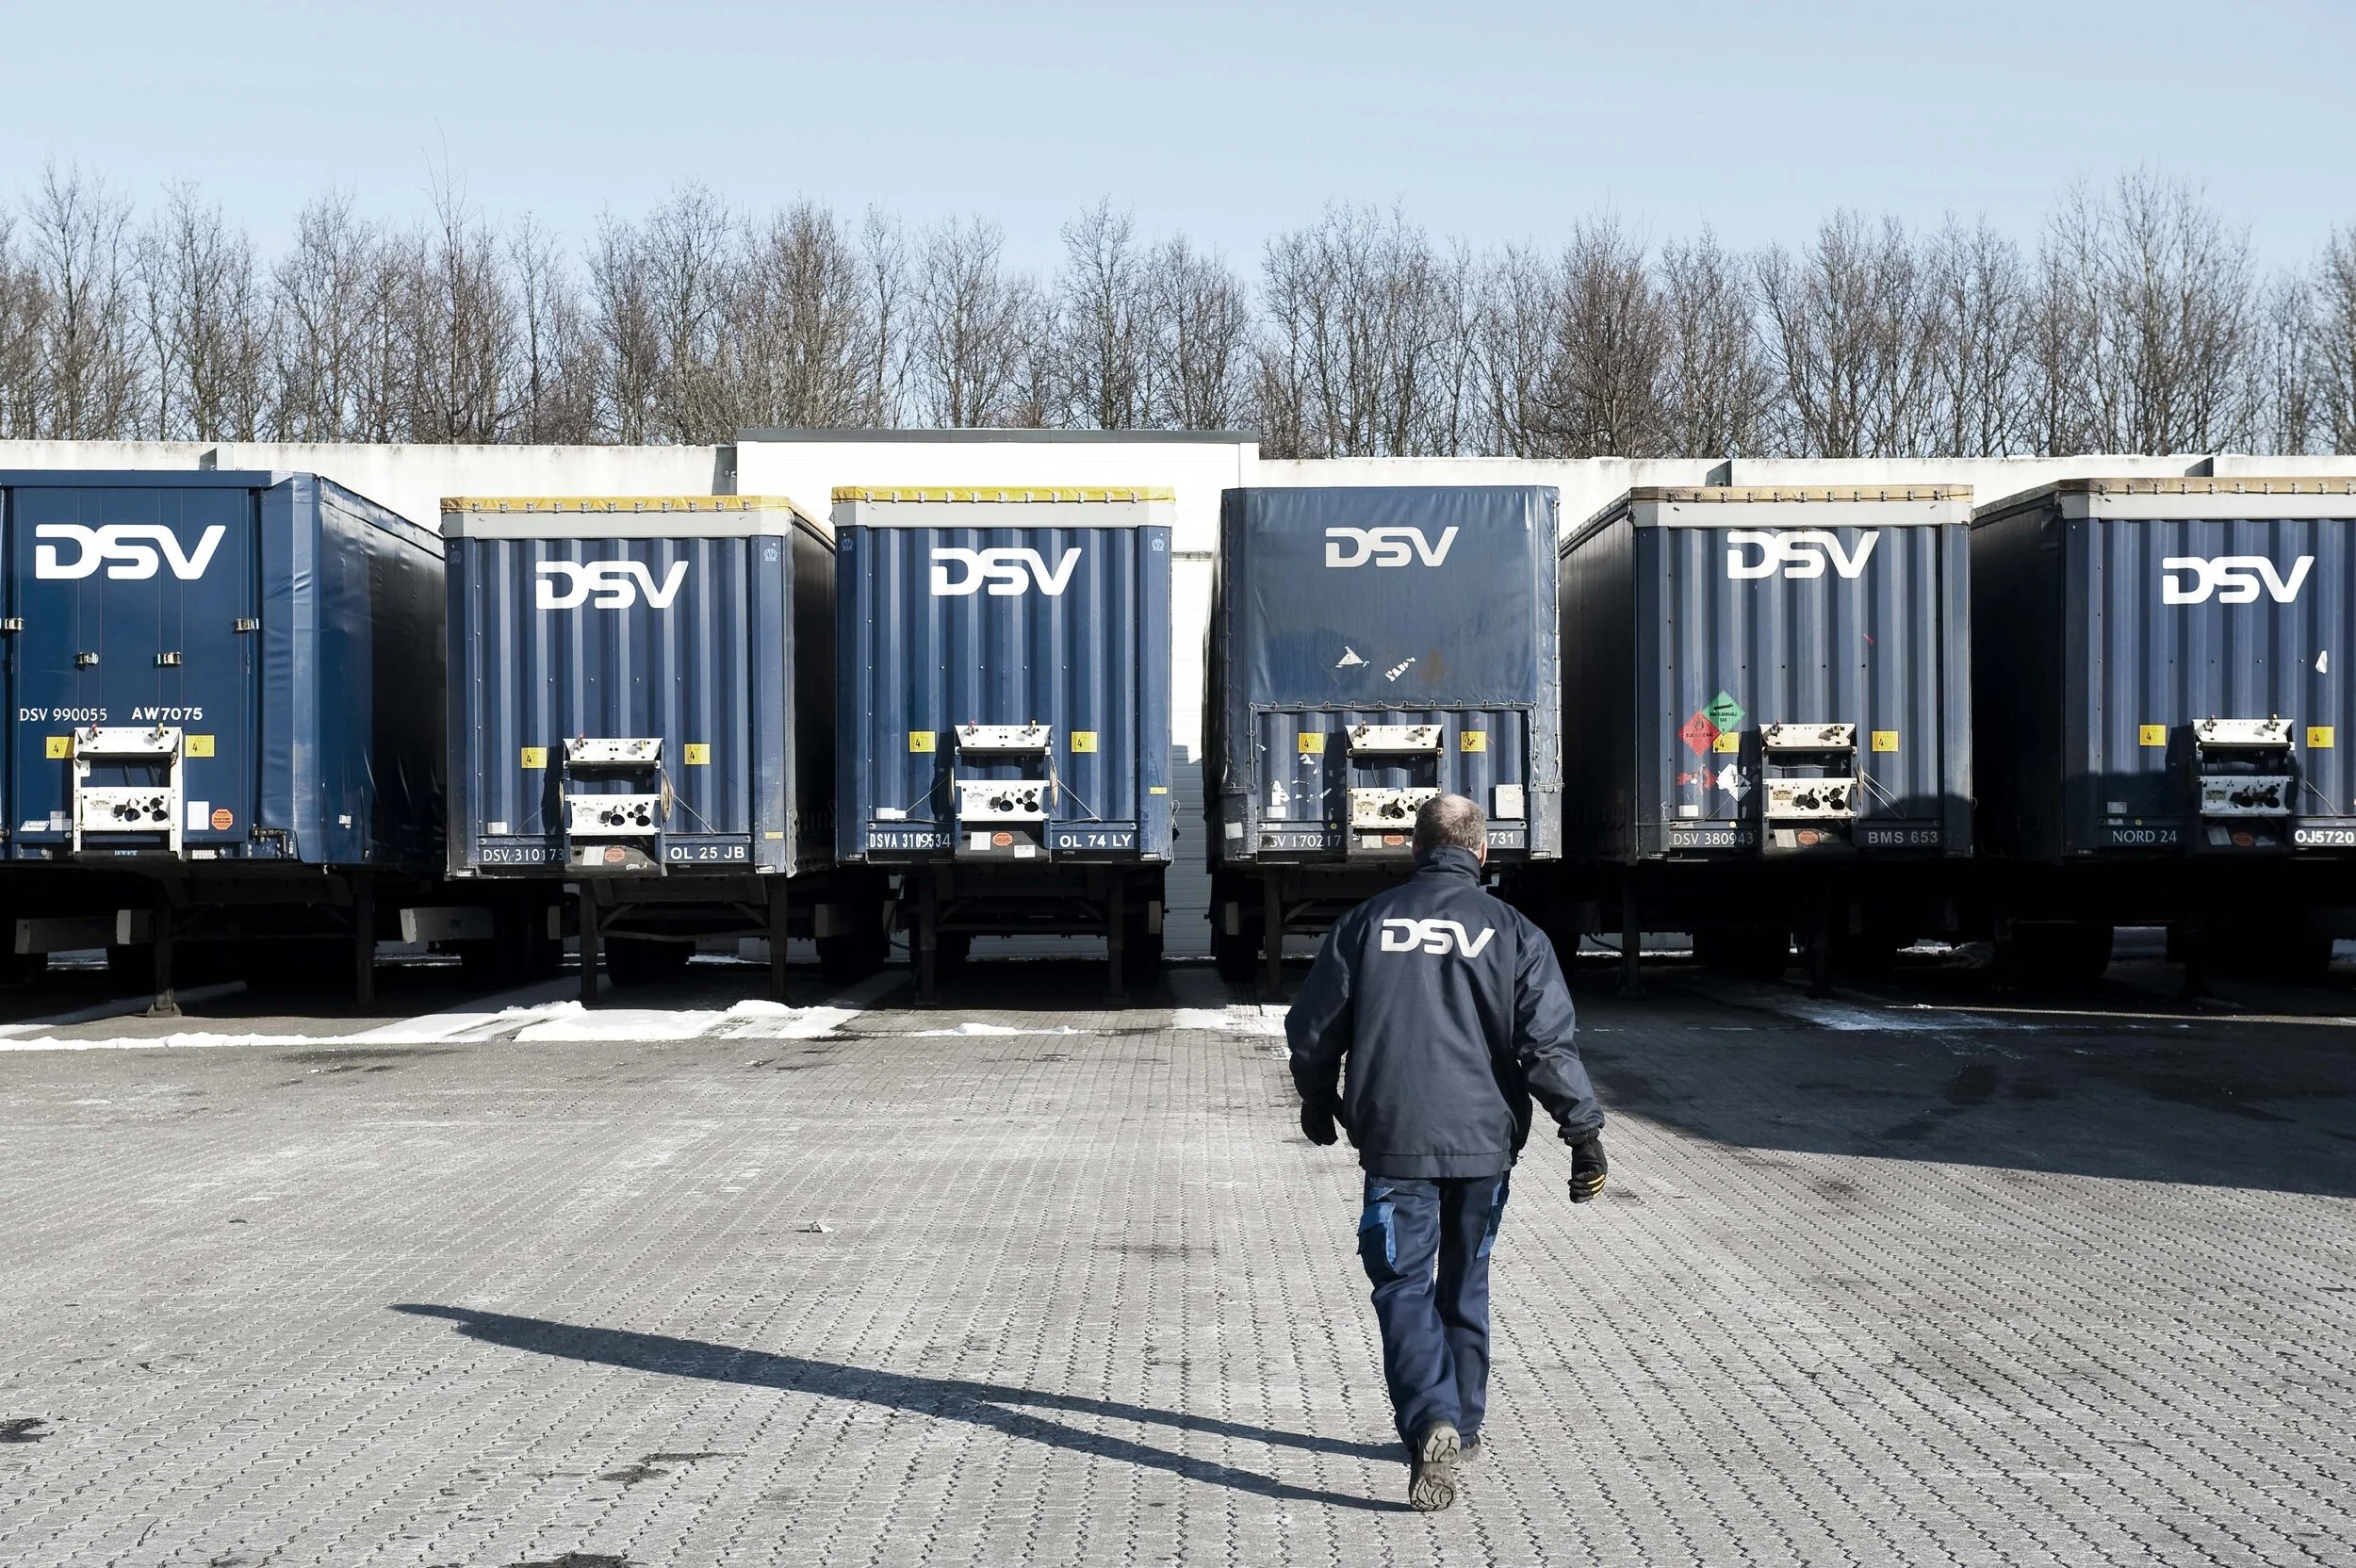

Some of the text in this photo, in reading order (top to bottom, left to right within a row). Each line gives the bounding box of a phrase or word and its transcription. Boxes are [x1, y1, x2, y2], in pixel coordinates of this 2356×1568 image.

[35, 524, 226, 580] DSV
[1325, 526, 1459, 567] DSV
[1726, 531, 1880, 580] DSV
[930, 547, 1082, 596] DSV
[535, 561, 689, 609] DSV
[2162, 555, 2315, 604] DSV
[19, 708, 107, 722] DSV 990055
[131, 707, 204, 721] AW7075
[914, 738, 921, 747] 4
[1077, 738, 1084, 747] 4
[1303, 739, 1310, 748] 4
[1719, 739, 1725, 748] 4
[1878, 738, 1885, 747] 4
[2146, 731, 2152, 742] 4
[2314, 733, 2320, 743] 4
[53, 744, 59, 754] 4
[192, 743, 198, 753] 4
[689, 750, 695, 760] 4
[526, 754, 532, 764] 4
[869, 833, 898, 848] DSVA
[1059, 834, 1132, 848] OL 74 LY
[1259, 834, 1342, 848] SV 170217
[1489, 832, 1514, 845] 731
[1673, 832, 1754, 845] DSV 380943
[1868, 830, 1939, 844] BMS 653
[2112, 829, 2178, 843] NORD 24
[2294, 829, 2355, 844] OJ5720
[483, 848, 565, 862] DSV 310173
[670, 846, 745, 860] OL 25 JB
[1381, 918, 1496, 958] DSV
